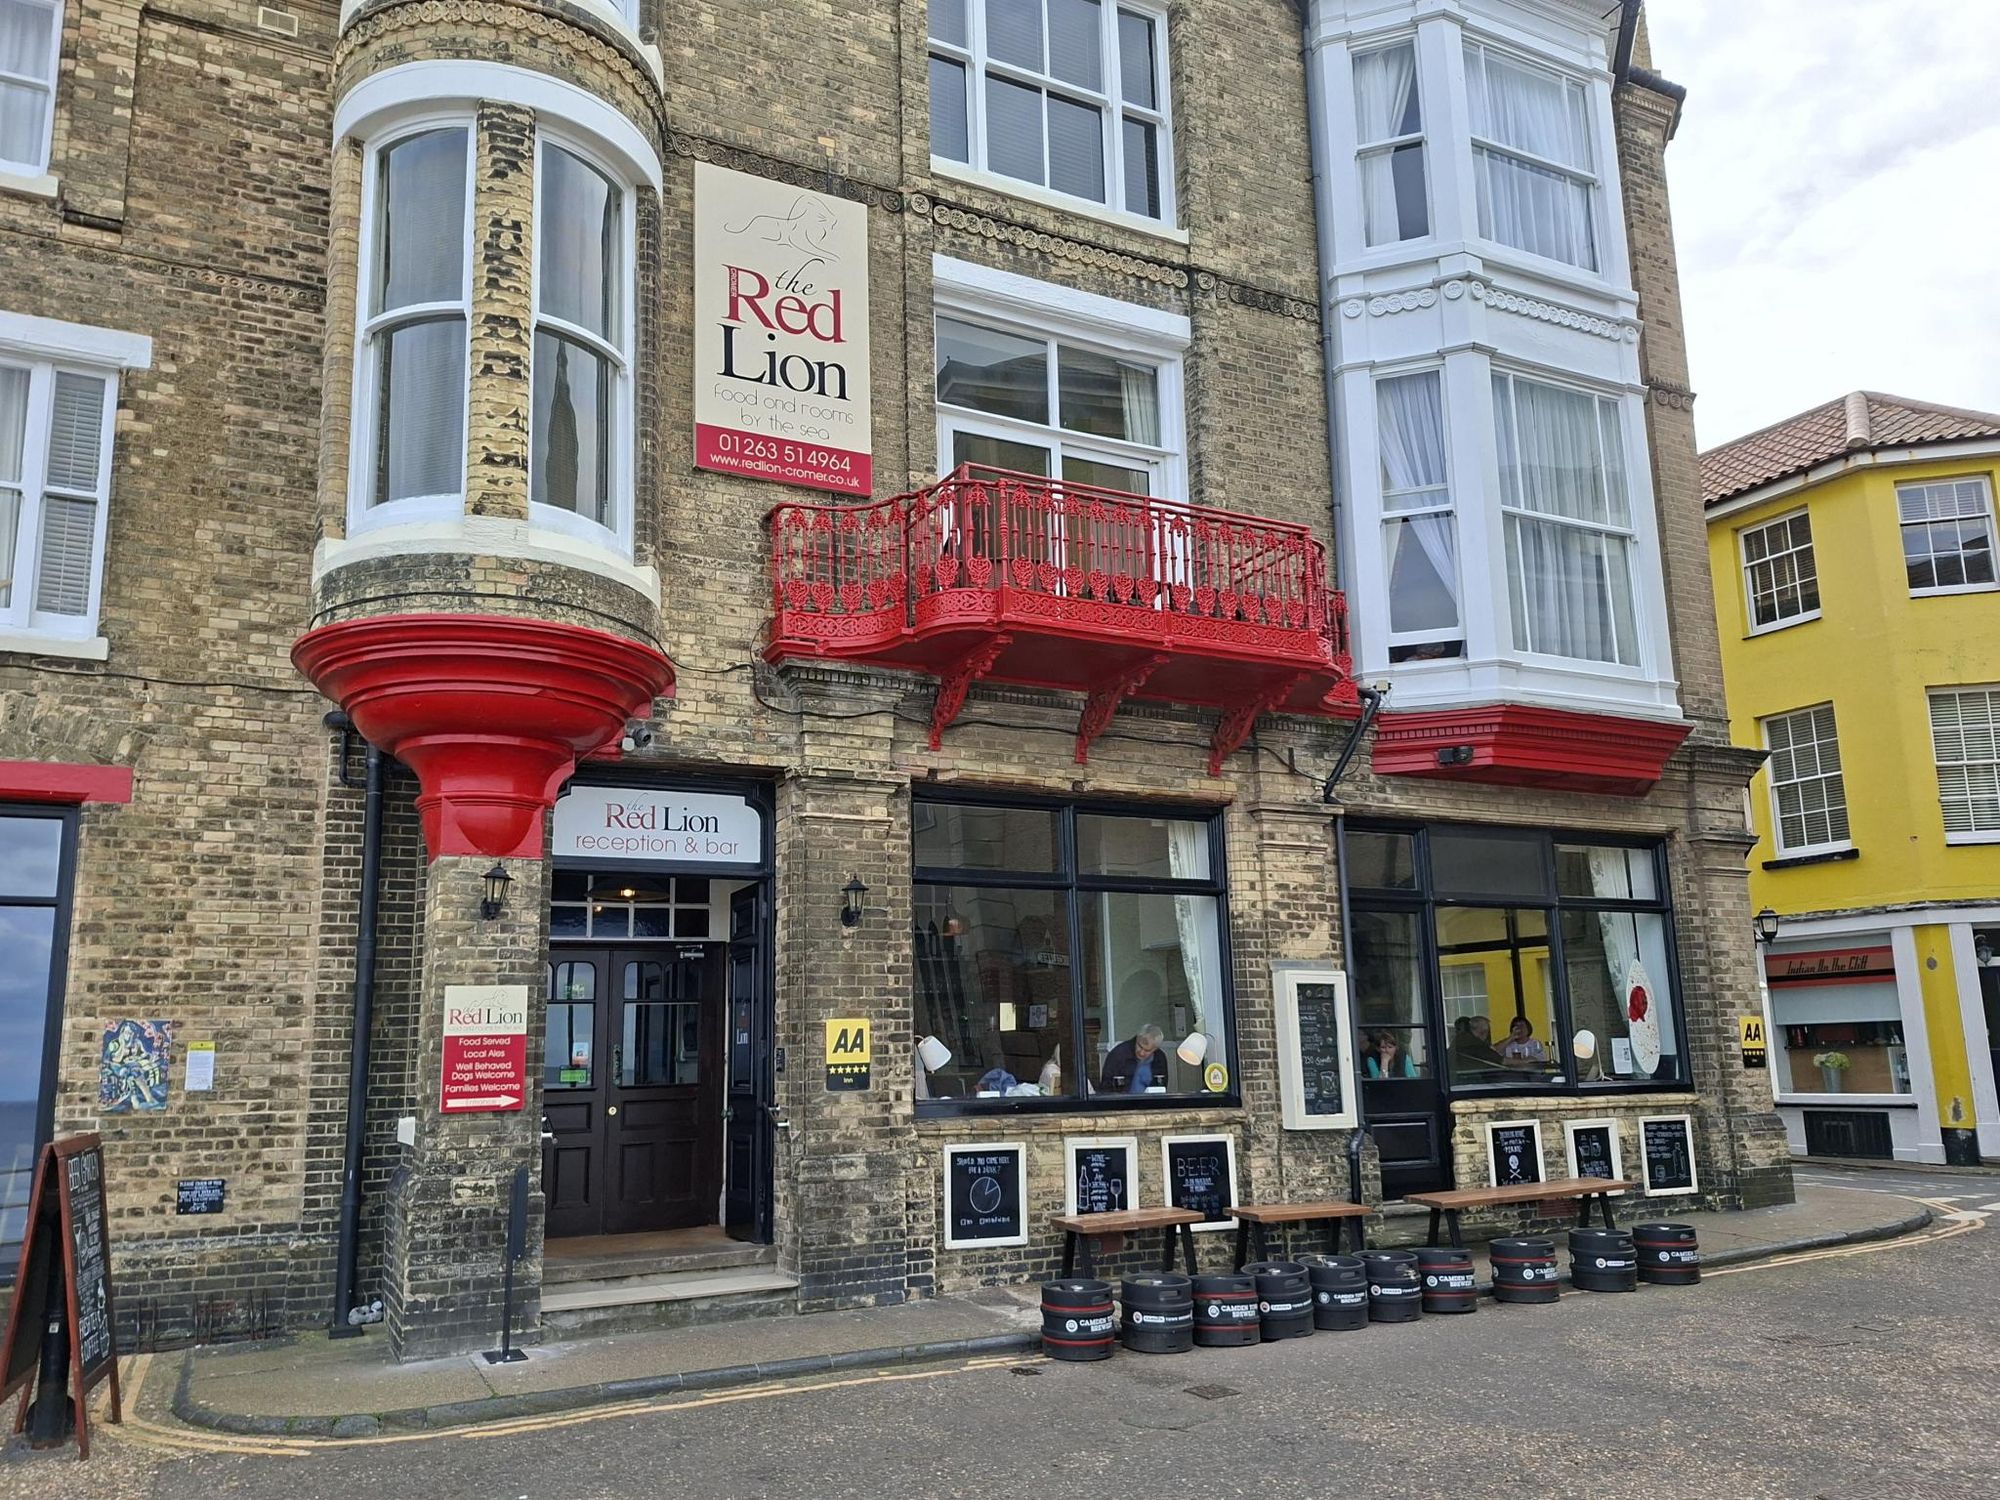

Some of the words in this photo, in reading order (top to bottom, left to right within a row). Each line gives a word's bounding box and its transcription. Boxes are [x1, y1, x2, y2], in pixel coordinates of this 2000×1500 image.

[730, 267, 738, 298] CROMER
[775, 258, 825, 296] the
[721, 263, 847, 343] Red
[716, 322, 852, 402] Lion
[763, 396, 796, 413] and
[801, 403, 854, 425] rooms
[740, 407, 761, 427] by
[768, 414, 794, 433] the
[799, 424, 830, 440] sea
[719, 433, 778, 460] 01263
[784, 446, 851, 472] 514964
[710, 453, 860, 488] www.redlion-cromer.co.uk
[626, 792, 649, 812] the
[605, 803, 656, 830] Red
[662, 806, 720, 833] Lion
[575, 834, 677, 855] reception
[684, 836, 699, 854] &
[705, 838, 739, 855] bar
[449, 1007, 482, 1025] Red
[485, 1007, 523, 1025] Lion
[459, 1037, 481, 1046] Food
[482, 1036, 511, 1046] Served
[832, 1028, 864, 1053] AA
[1744, 1023, 1761, 1041] AA
[456, 1062, 474, 1071] Well
[475, 1061, 512, 1071] Behaved
[463, 1050, 487, 1058] Local
[488, 1049, 505, 1058] Ales
[445, 1083, 479, 1093] Families
[480, 1082, 520, 1091] Welcome
[451, 1071, 473, 1081] Dogs
[475, 1070, 515, 1079] Welcome
